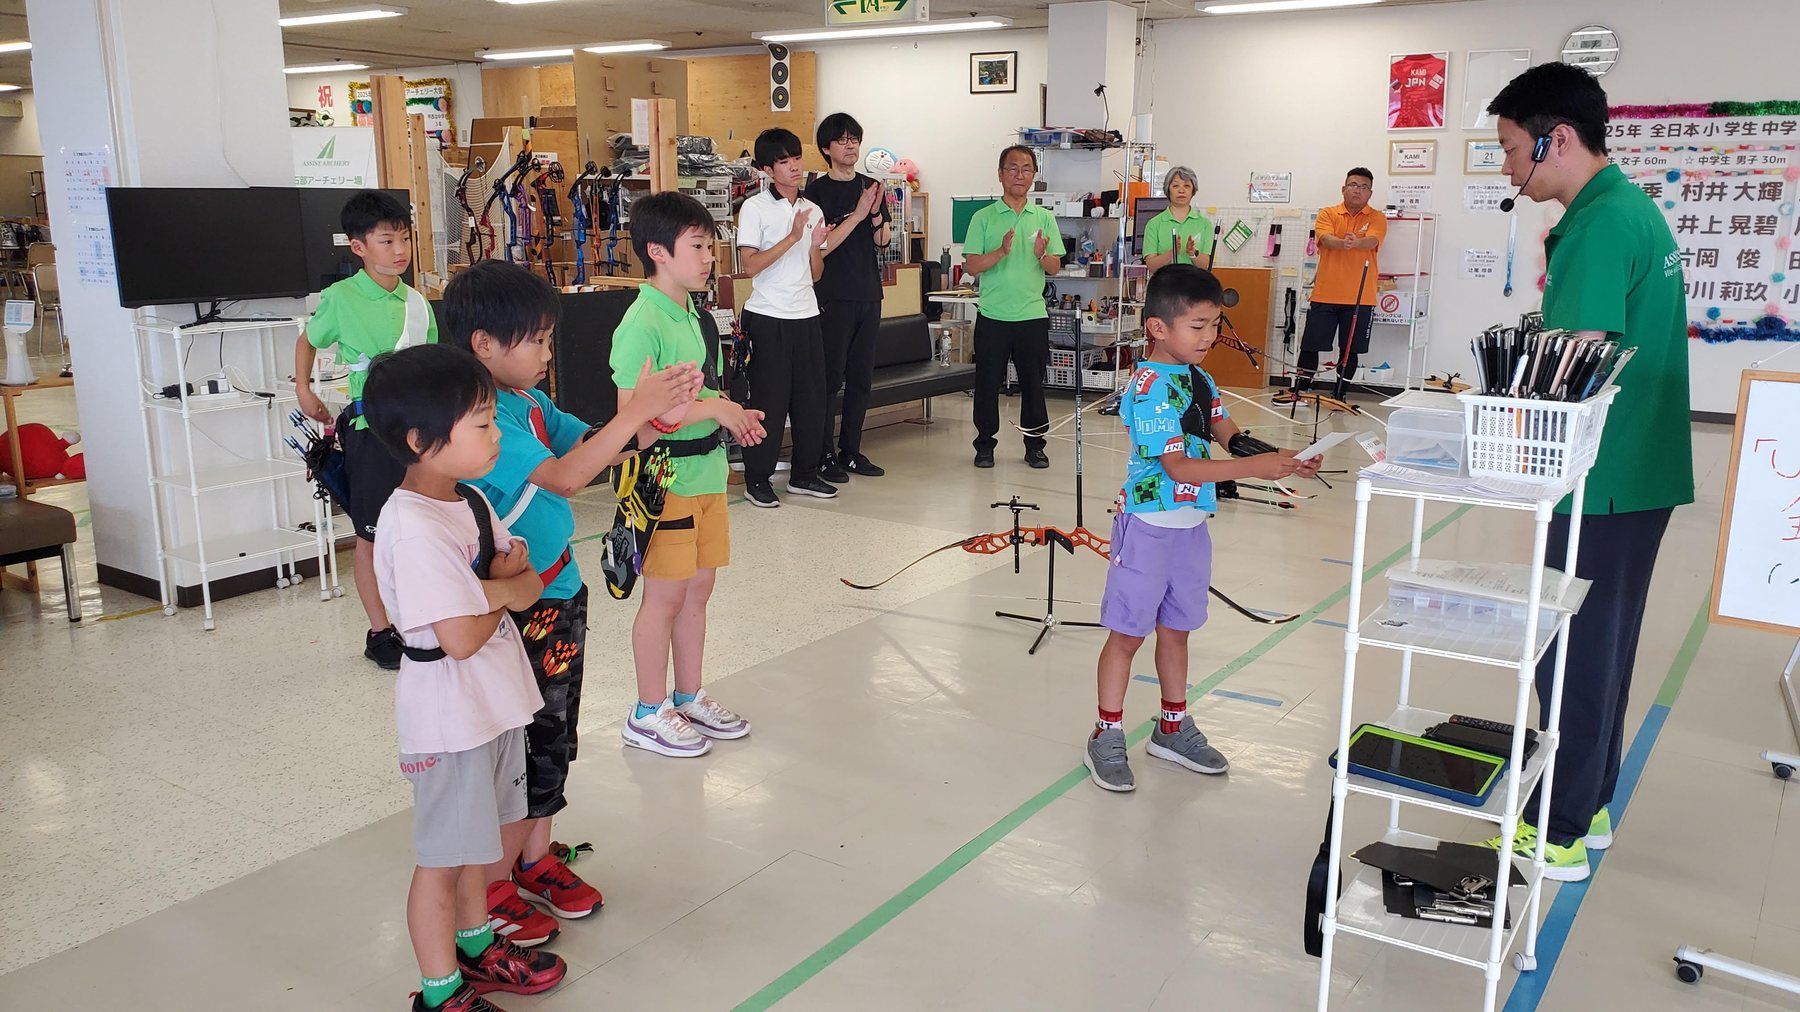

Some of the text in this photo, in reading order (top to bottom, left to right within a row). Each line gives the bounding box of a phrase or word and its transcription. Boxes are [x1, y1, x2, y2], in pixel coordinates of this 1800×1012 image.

[1410, 68, 1427, 76] KAMI
[1405, 77, 1426, 88] JPN
[318, 85, 334, 108] 祝
[1484, 152, 1494, 160] 21
[1621, 156, 1641, 165] 女子
[1644, 156, 1667, 165] 60m
[1698, 155, 1787, 165] 中学生 男子 30m
[1677, 214, 1722, 235] 井上
[1736, 248, 1761, 269] 俊
